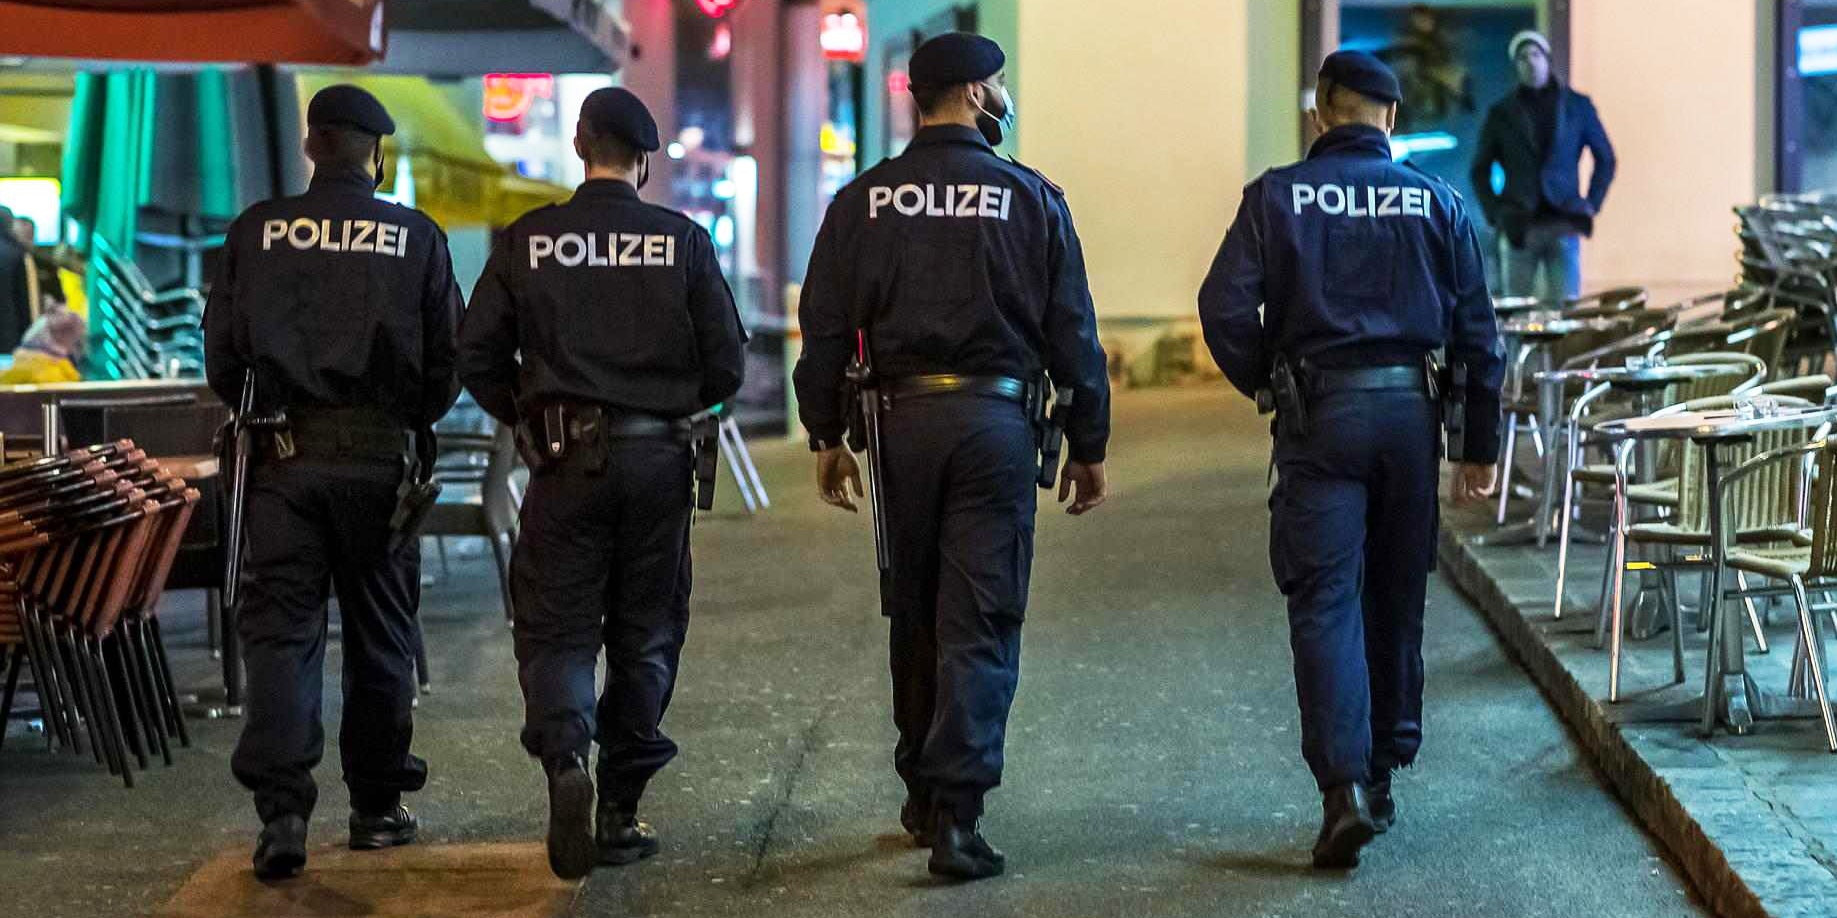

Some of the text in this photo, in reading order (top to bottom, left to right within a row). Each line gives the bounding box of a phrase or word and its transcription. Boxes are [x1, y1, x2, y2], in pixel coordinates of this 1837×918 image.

[869, 184, 1012, 220] POLIZEI
[1292, 184, 1431, 218] POLIZEI
[263, 218, 408, 258] POLIZEI
[529, 232, 675, 269] POLIZEI
